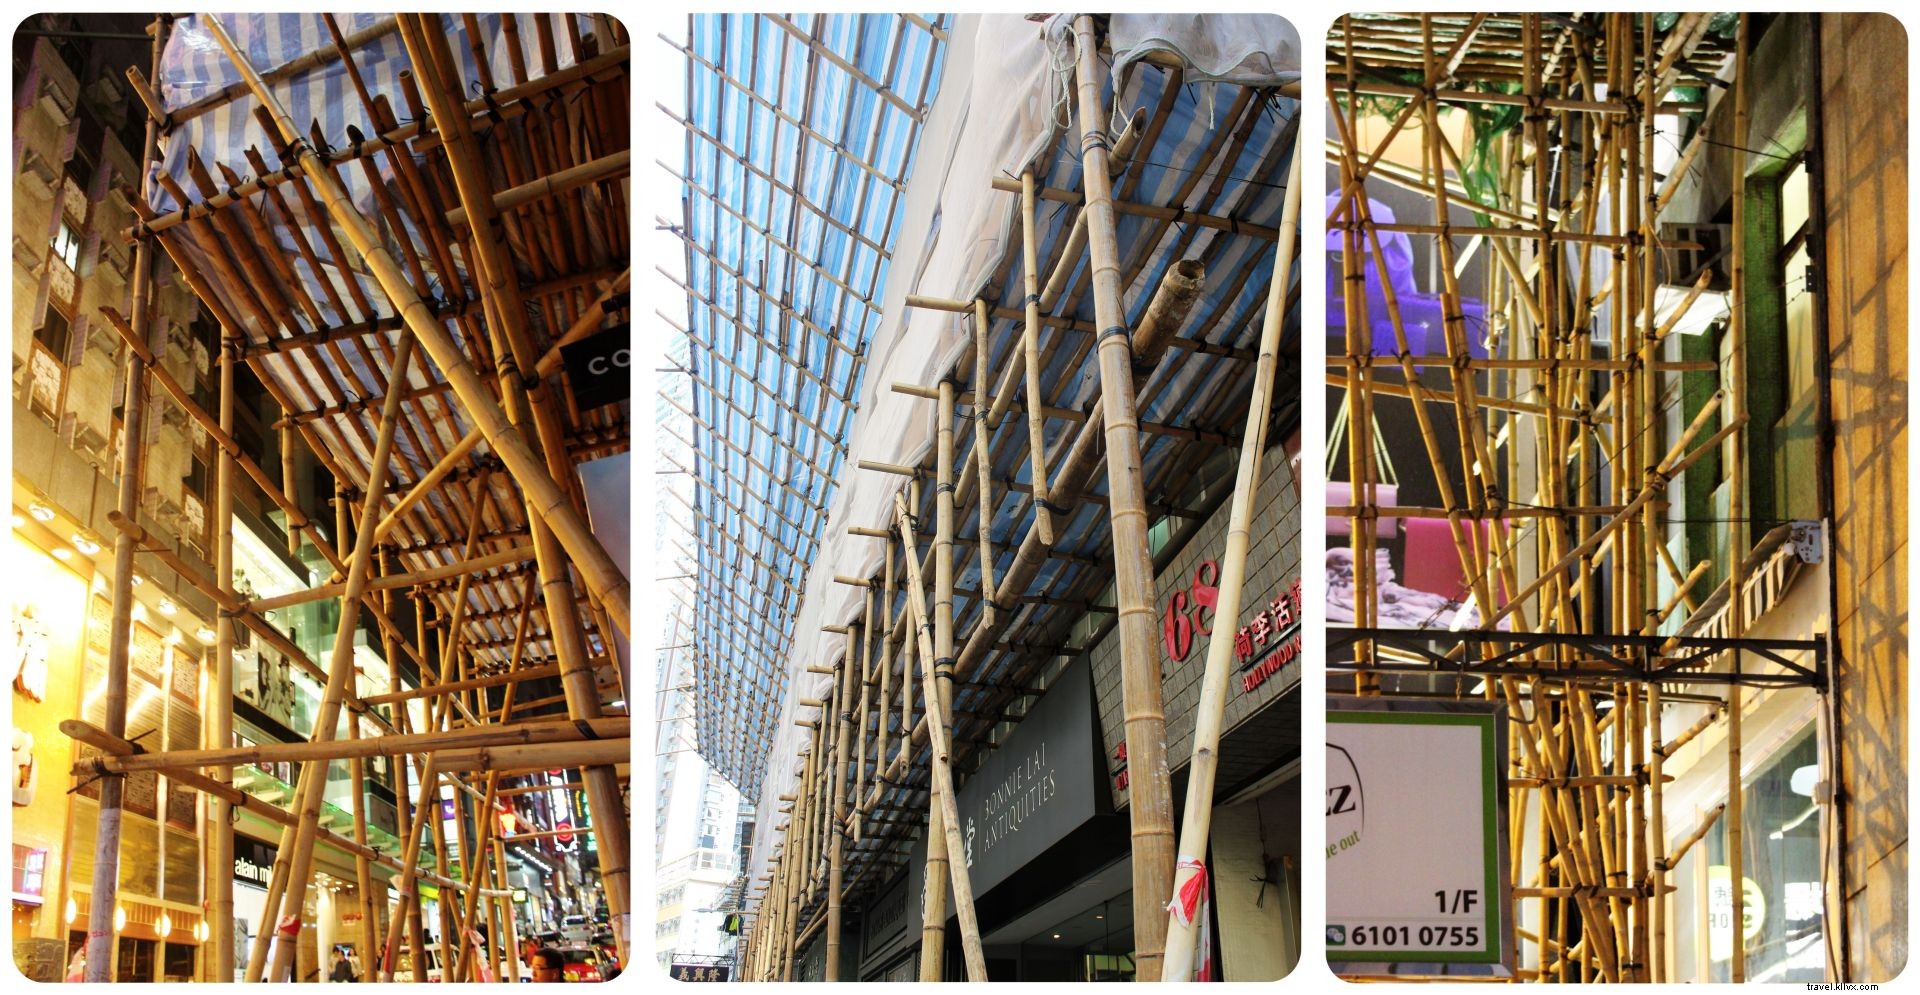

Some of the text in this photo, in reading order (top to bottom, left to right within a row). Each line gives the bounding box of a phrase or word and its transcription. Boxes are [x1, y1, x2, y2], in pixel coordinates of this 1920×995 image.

[1164, 560, 1219, 662] 68
[1243, 643, 1295, 693] HOLLYWOOD
[985, 742, 1045, 820] BONNIE LAI
[985, 769, 1055, 852] ANTIQUITIES
[1326, 785, 1356, 816] Z
[1339, 830, 1361, 851] out
[235, 857, 258, 880] alain
[1435, 889, 1478, 914] 1/F
[1352, 926, 1479, 946] 6101 0755
